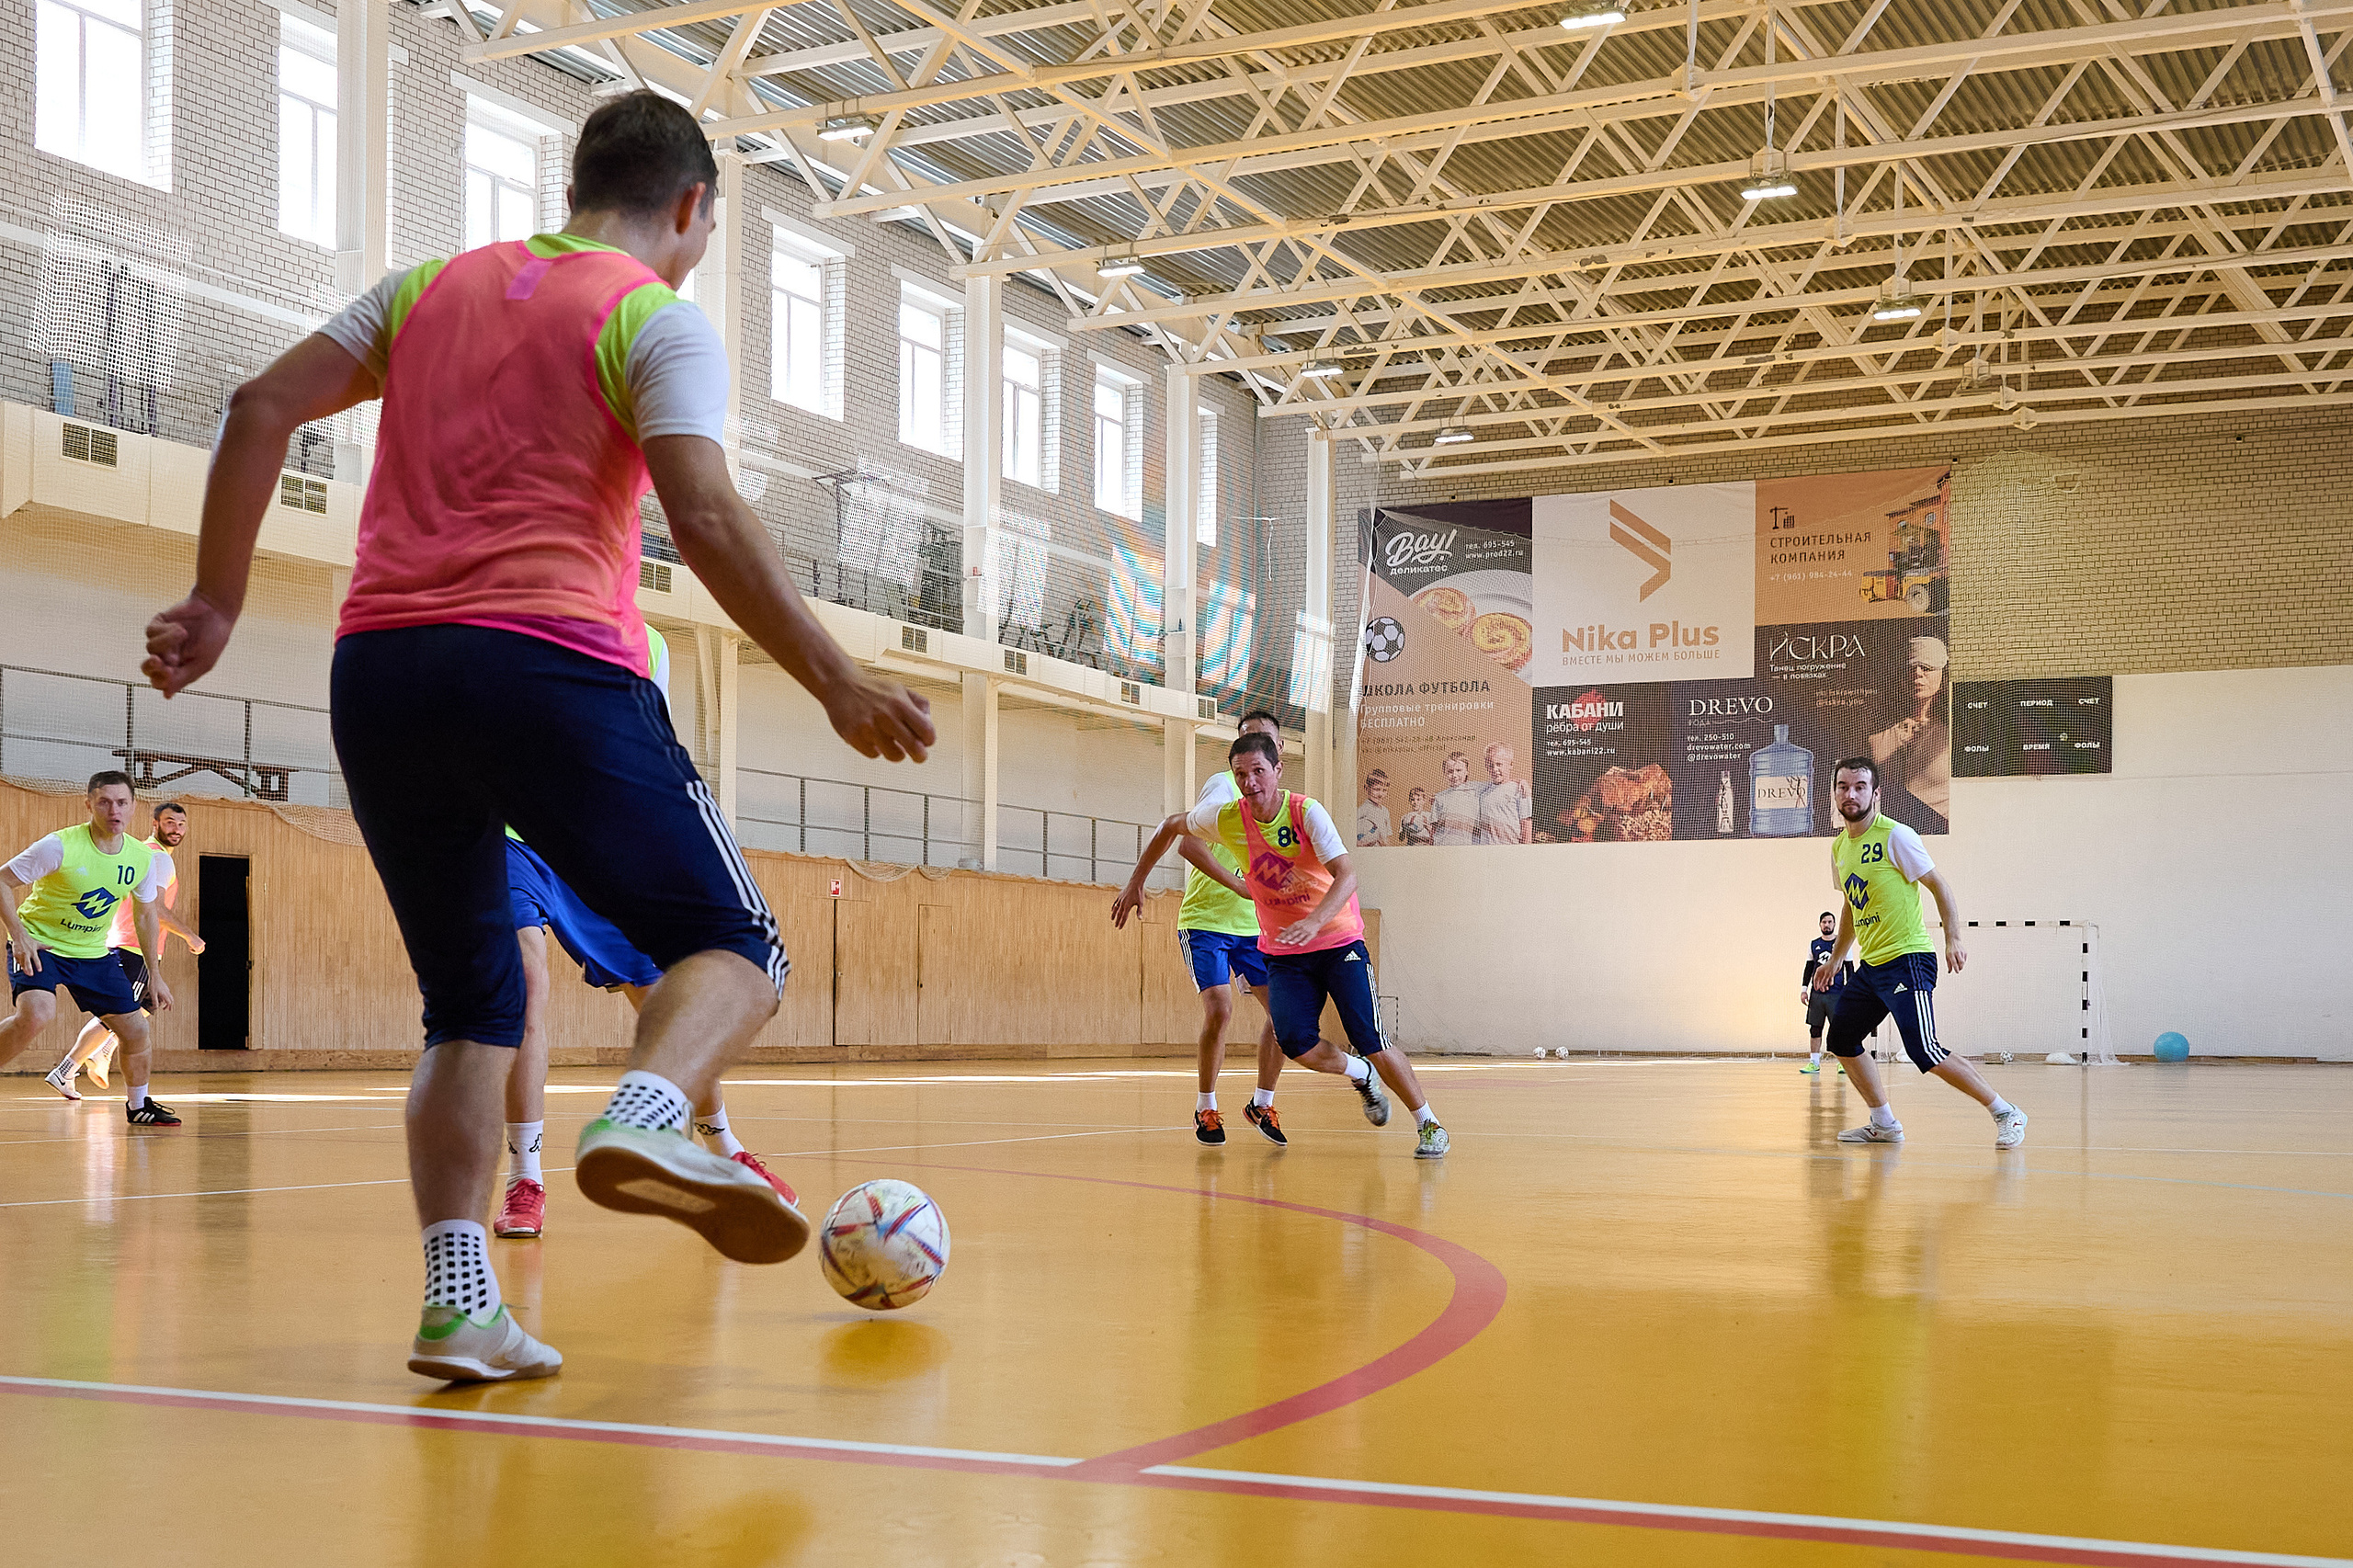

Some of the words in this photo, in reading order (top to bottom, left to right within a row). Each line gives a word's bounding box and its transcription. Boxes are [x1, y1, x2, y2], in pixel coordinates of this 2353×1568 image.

[1483, 540, 1515, 549] 695-545
[1770, 532, 1871, 548] СТРОИТЕЛЬНАЯ
[1465, 549, 1524, 559] www.prod22.ru
[1770, 551, 1845, 564] КОМПАНИЯ
[1563, 624, 1637, 653] Nika
[1649, 620, 1720, 648] Plus
[1563, 654, 1601, 665] ВМЕСТЕ
[1606, 653, 1624, 664] МЫ
[1628, 652, 1669, 663] МОЖЕМ
[1674, 649, 1721, 660] БОЛЬШЕ
[1419, 680, 1491, 694] ФУТБОЛА
[1426, 700, 1494, 713] тренировки
[1546, 701, 1624, 719] КАБАНИ
[1688, 696, 1773, 715] DREVO
[1360, 716, 1426, 728] БЕСПЛАТНО
[1582, 722, 1594, 731] от
[1595, 721, 1624, 733] души
[1704, 733, 1734, 742] 250-510
[1546, 747, 1616, 756] www.kabani22.ru
[1687, 743, 1752, 751] drevowater.com
[1964, 744, 1990, 753] ФОЛЫ
[2074, 742, 2100, 750] ФОЛЫ
[1687, 752, 1742, 762] @drevowater
[1757, 787, 1806, 799] DREVO
[1861, 842, 1883, 864] 29
[118, 865, 135, 885] 10
